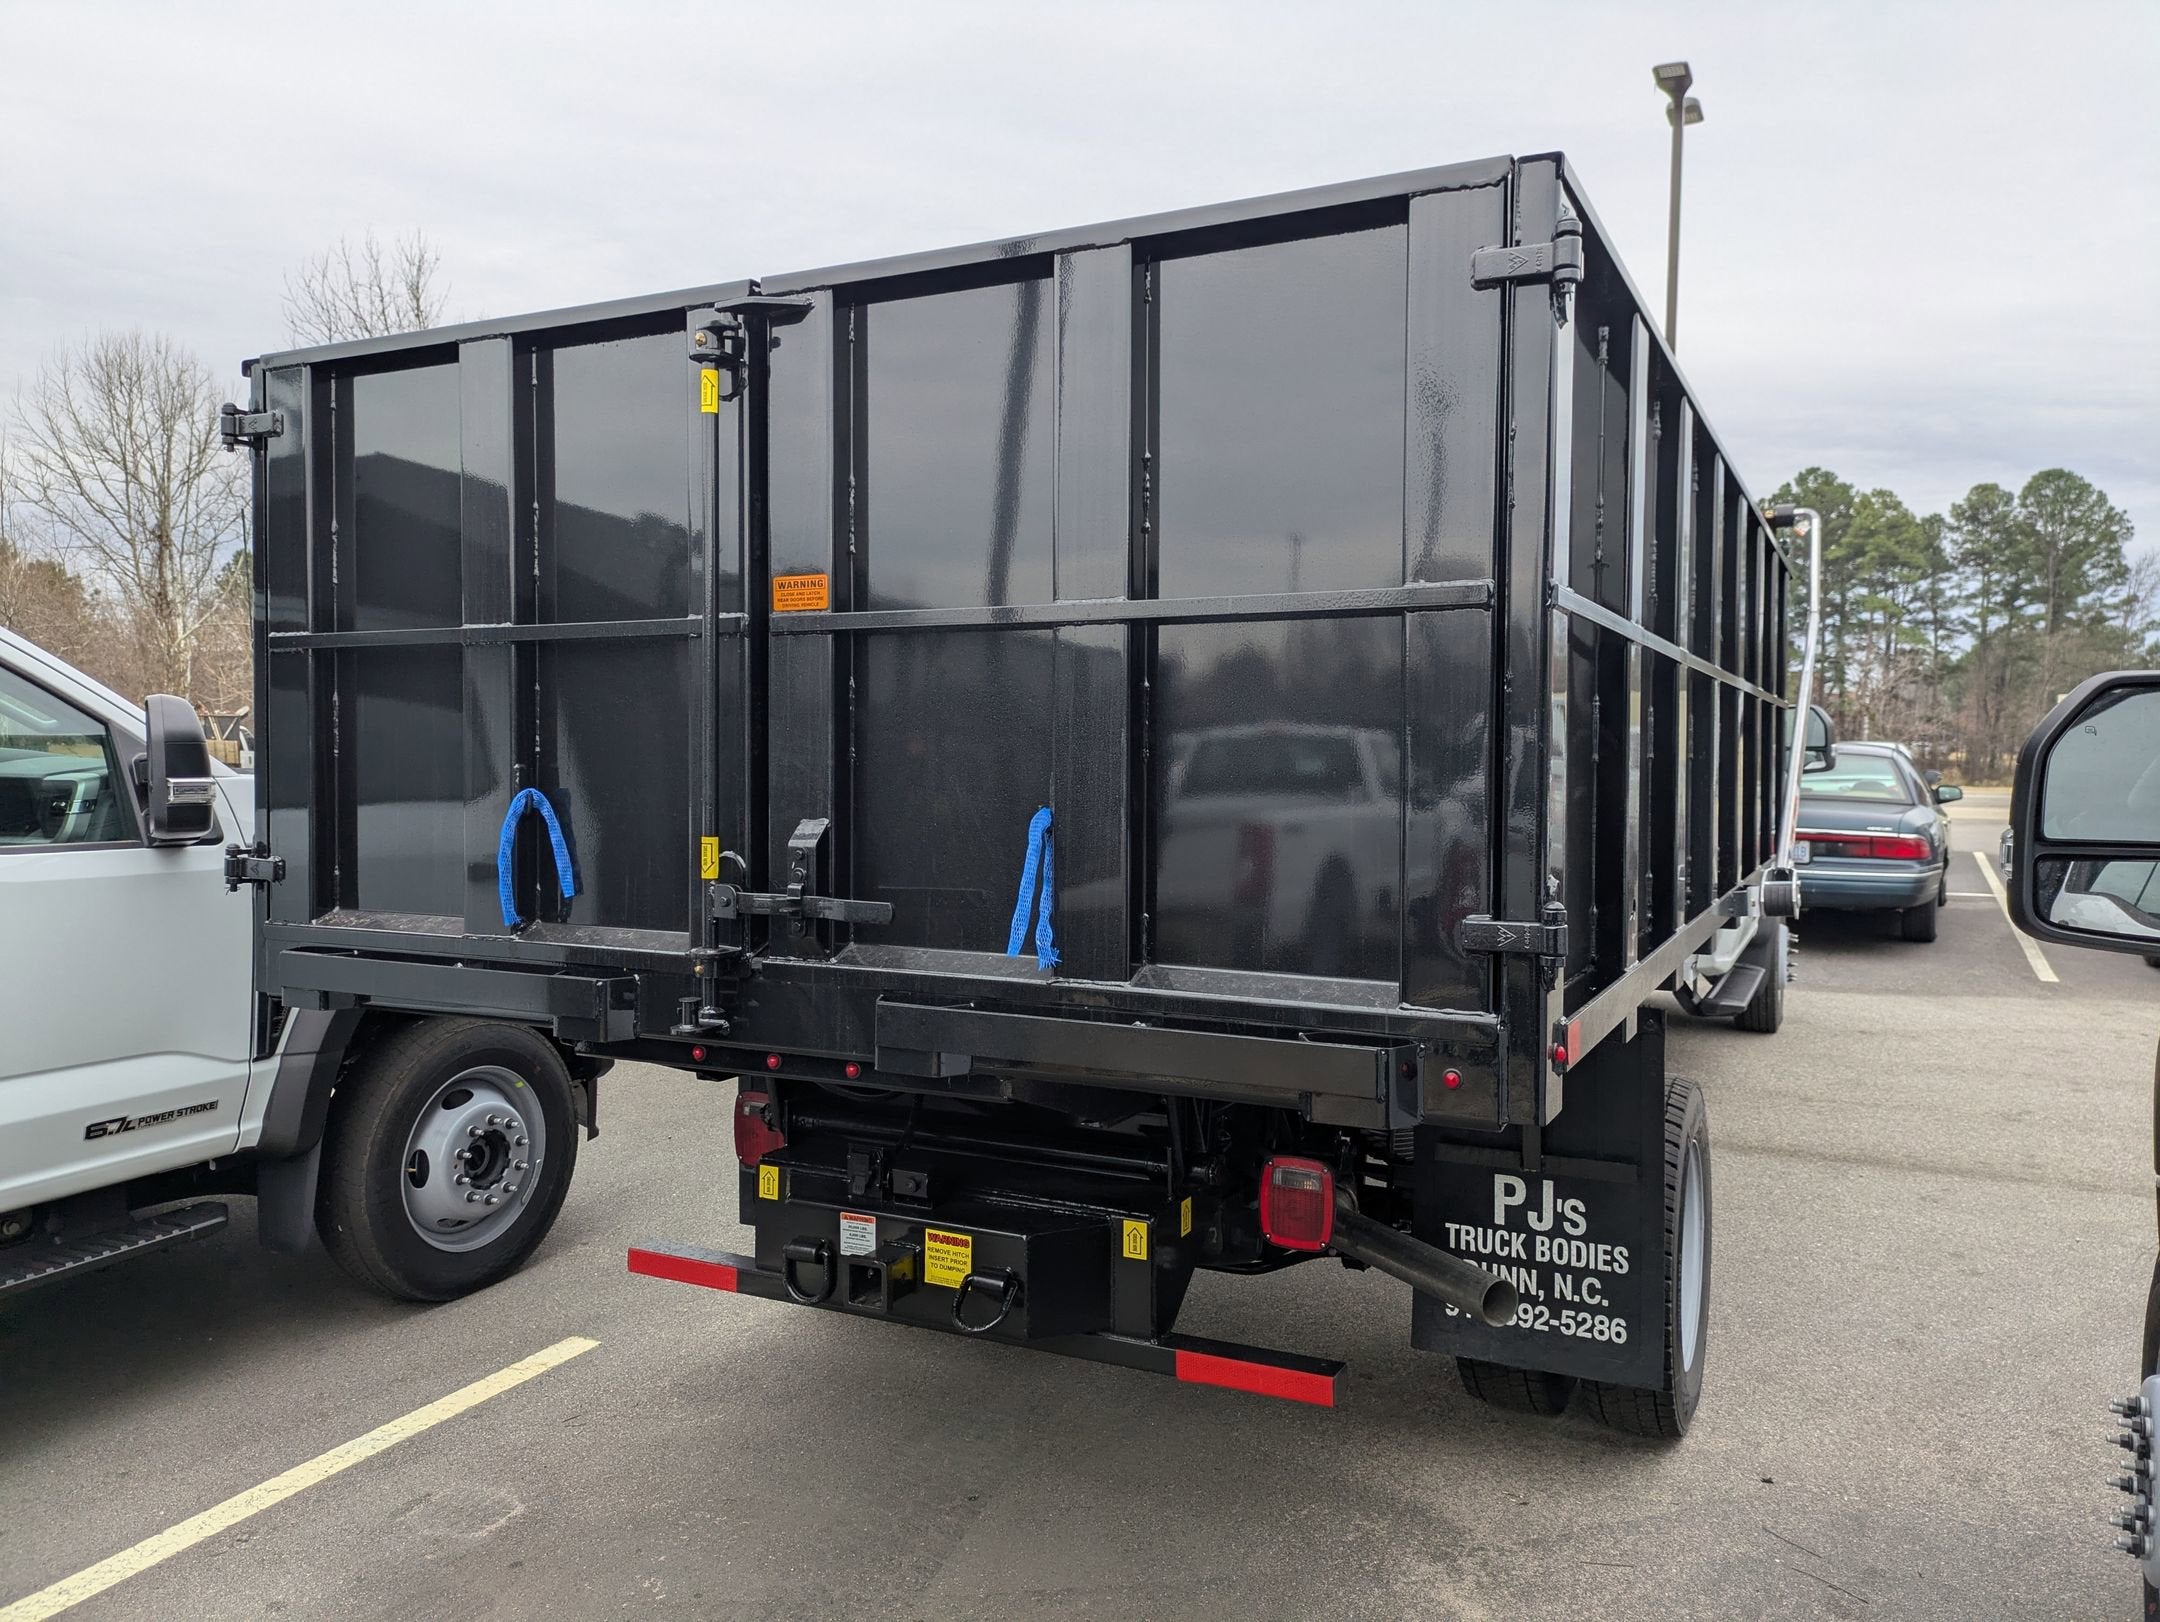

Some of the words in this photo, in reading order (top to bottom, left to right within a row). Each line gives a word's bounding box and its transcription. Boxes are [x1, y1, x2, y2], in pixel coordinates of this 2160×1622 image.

[777, 579, 824, 590] WARNING
[138, 1110, 175, 1126] POWER
[176, 1100, 218, 1117] STROKE
[927, 1231, 970, 1249] WARNING
[928, 1246, 951, 1256] REMOVE
[952, 1251, 969, 1259] HITCH
[1445, 1222, 1527, 1260] TRUCK
[1535, 1235, 1629, 1274] BODIES
[929, 1255, 949, 1263] INSERT
[950, 1258, 967, 1267] PRIOR
[939, 1264, 966, 1274] DUMPING
[1554, 1272, 1609, 1307] N.C.
